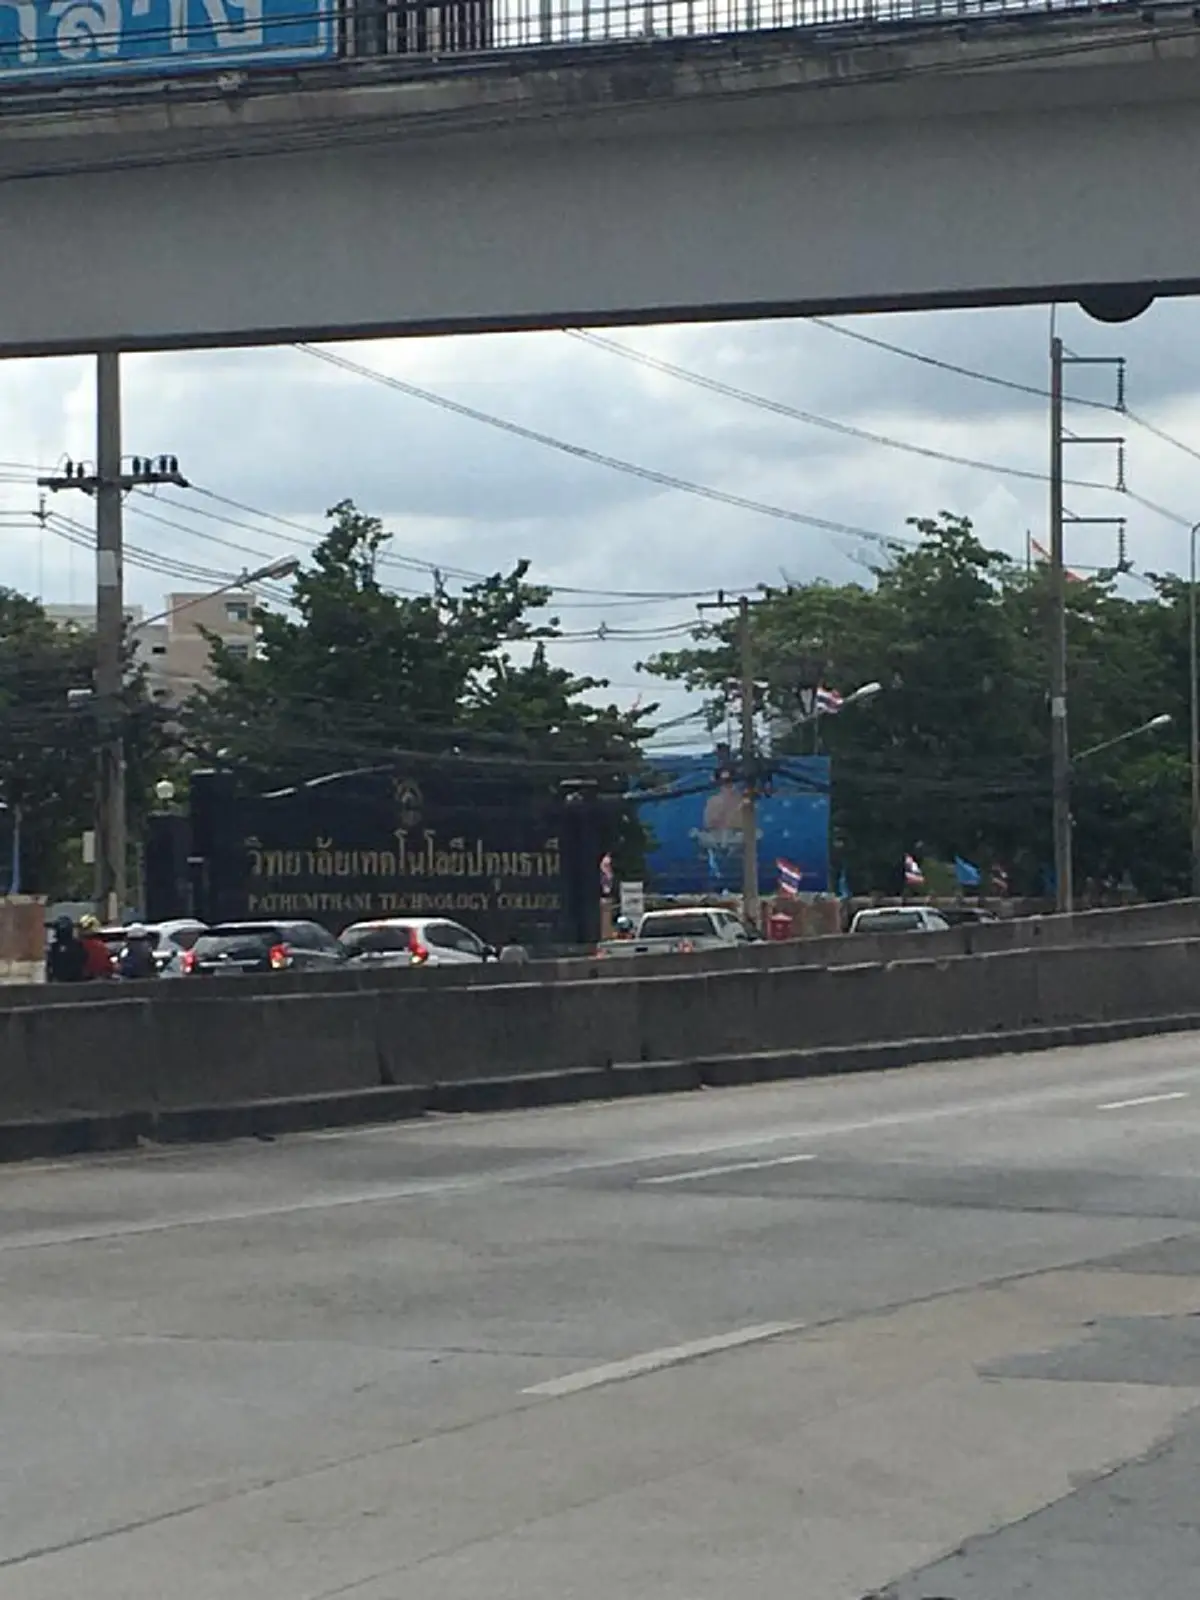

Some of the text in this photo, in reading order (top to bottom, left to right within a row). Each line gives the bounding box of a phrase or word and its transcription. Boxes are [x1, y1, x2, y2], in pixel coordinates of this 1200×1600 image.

[244, 829, 561, 891] วิทยาลัยเทคโนโลยีปทุมธานี
[249, 891, 561, 912] PATHUMTHANI TECHNOLOGY COLLEGE
